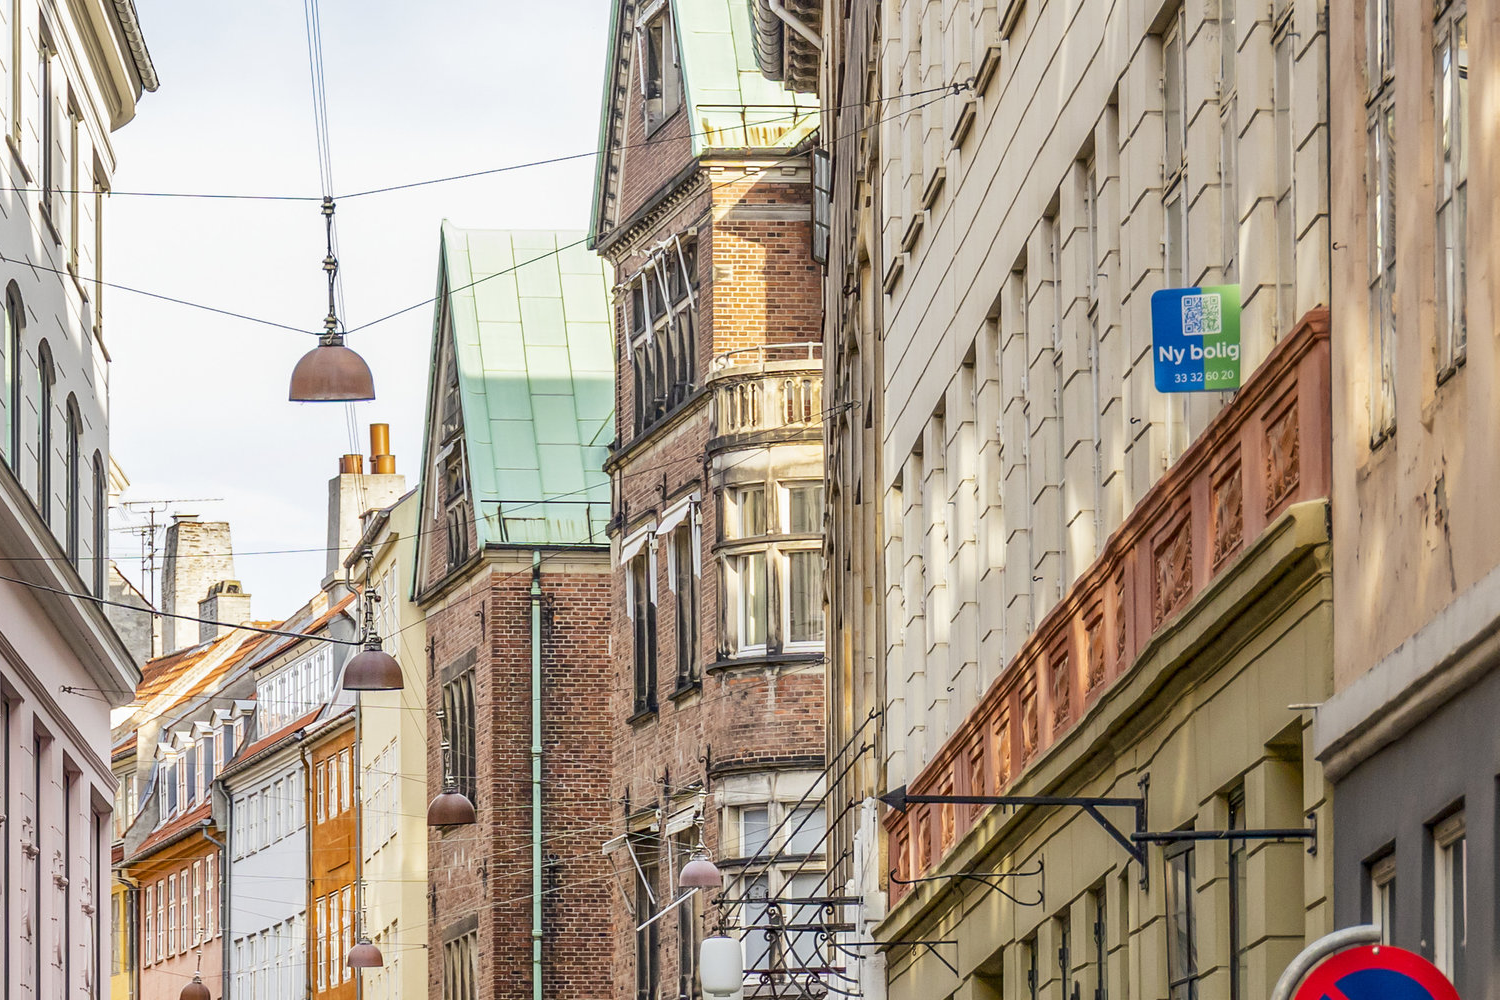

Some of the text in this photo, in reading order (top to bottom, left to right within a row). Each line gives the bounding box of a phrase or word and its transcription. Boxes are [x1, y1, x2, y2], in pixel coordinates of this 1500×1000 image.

[1174, 370, 1234, 383] 33 32 60 20
